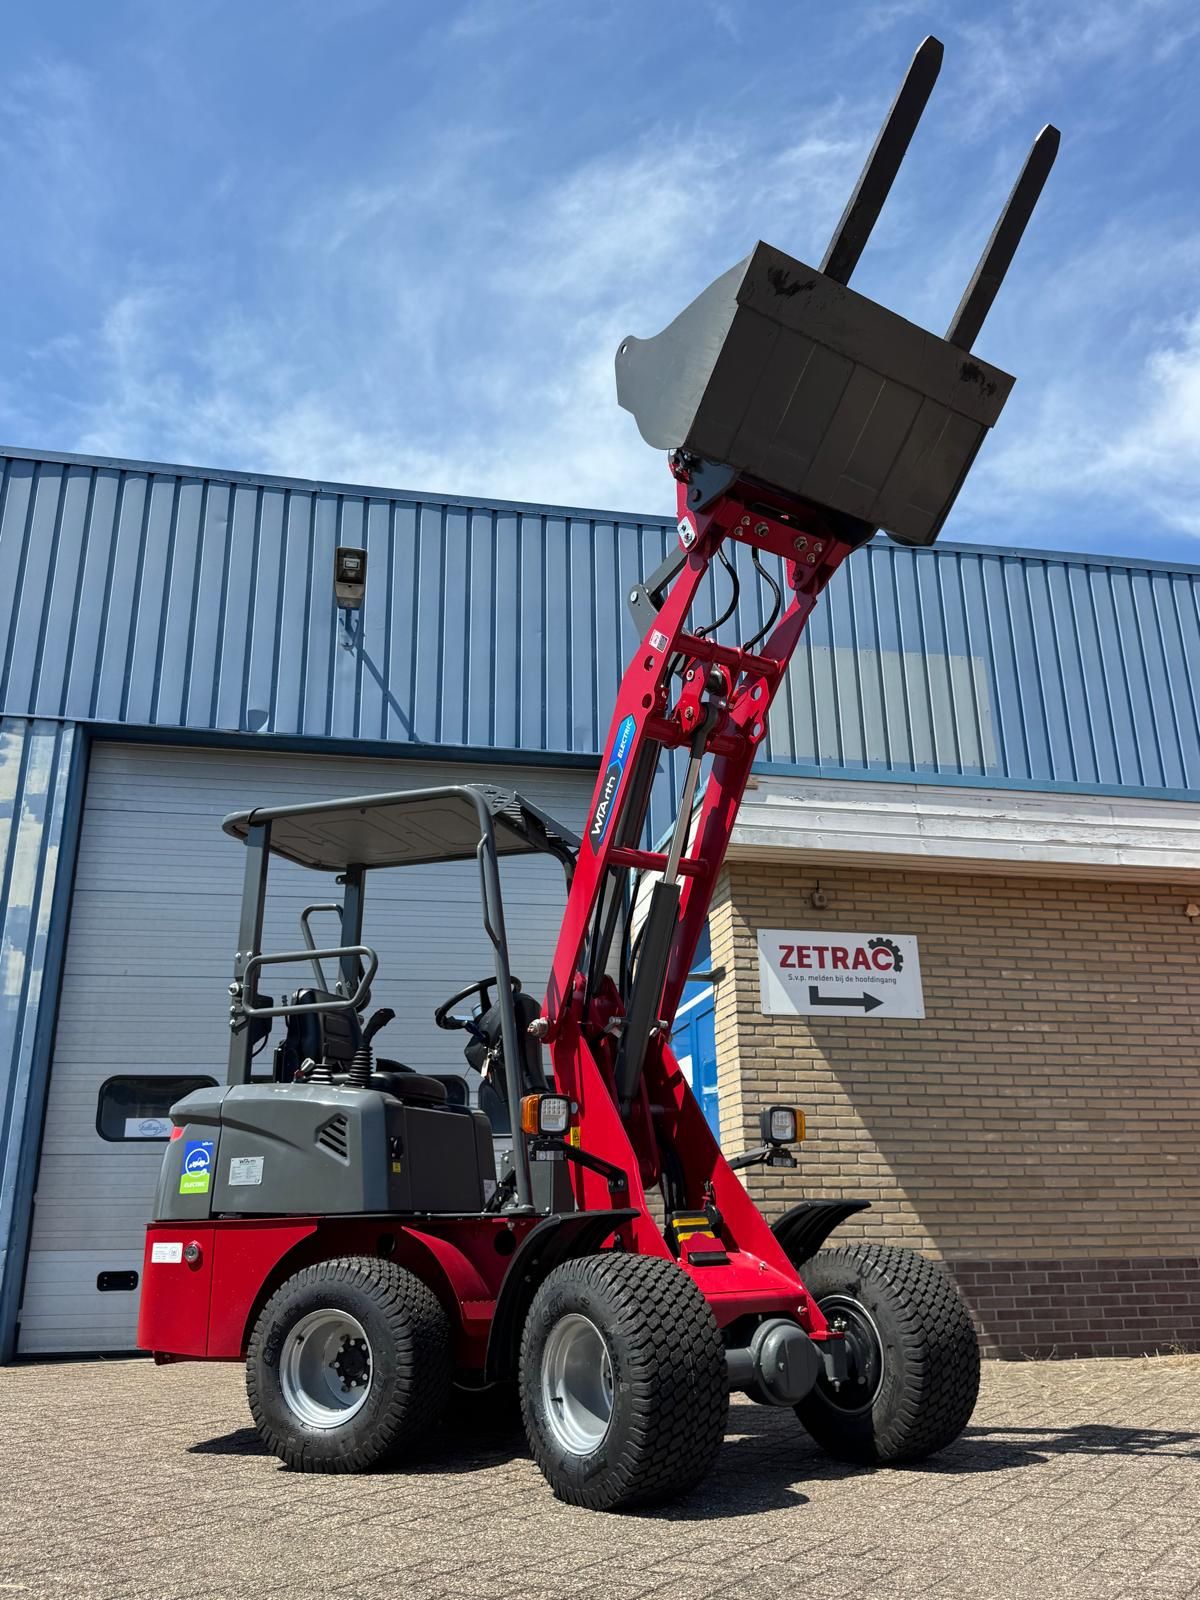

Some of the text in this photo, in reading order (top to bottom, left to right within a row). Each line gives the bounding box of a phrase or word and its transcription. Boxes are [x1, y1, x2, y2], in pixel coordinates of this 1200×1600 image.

[617, 720, 633, 759] ELECTRIC
[778, 945, 893, 971] ZETRAC
[788, 974, 807, 982] S.v.p.
[835, 975, 844, 984] bij
[855, 976, 897, 985] hoofdingang
